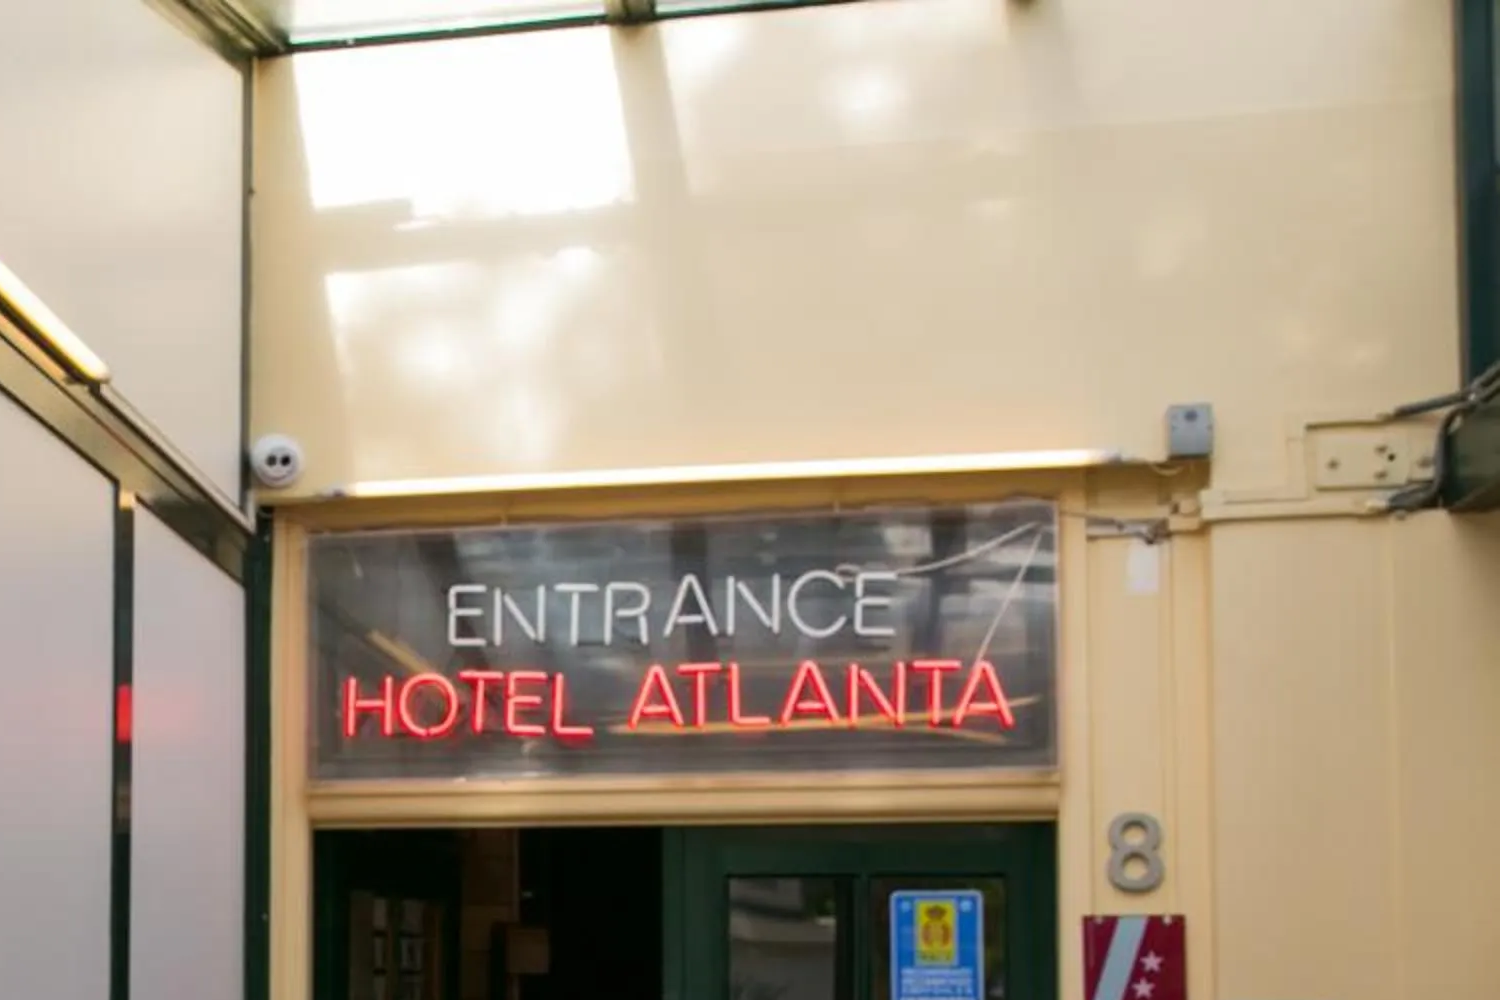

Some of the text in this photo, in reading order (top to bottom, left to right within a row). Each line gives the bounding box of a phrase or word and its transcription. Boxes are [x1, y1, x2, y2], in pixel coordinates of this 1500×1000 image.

[447, 570, 900, 647] ENTRANCE
[342, 660, 1014, 738] HOTEL ATLANTA
[1108, 812, 1164, 893] 8
